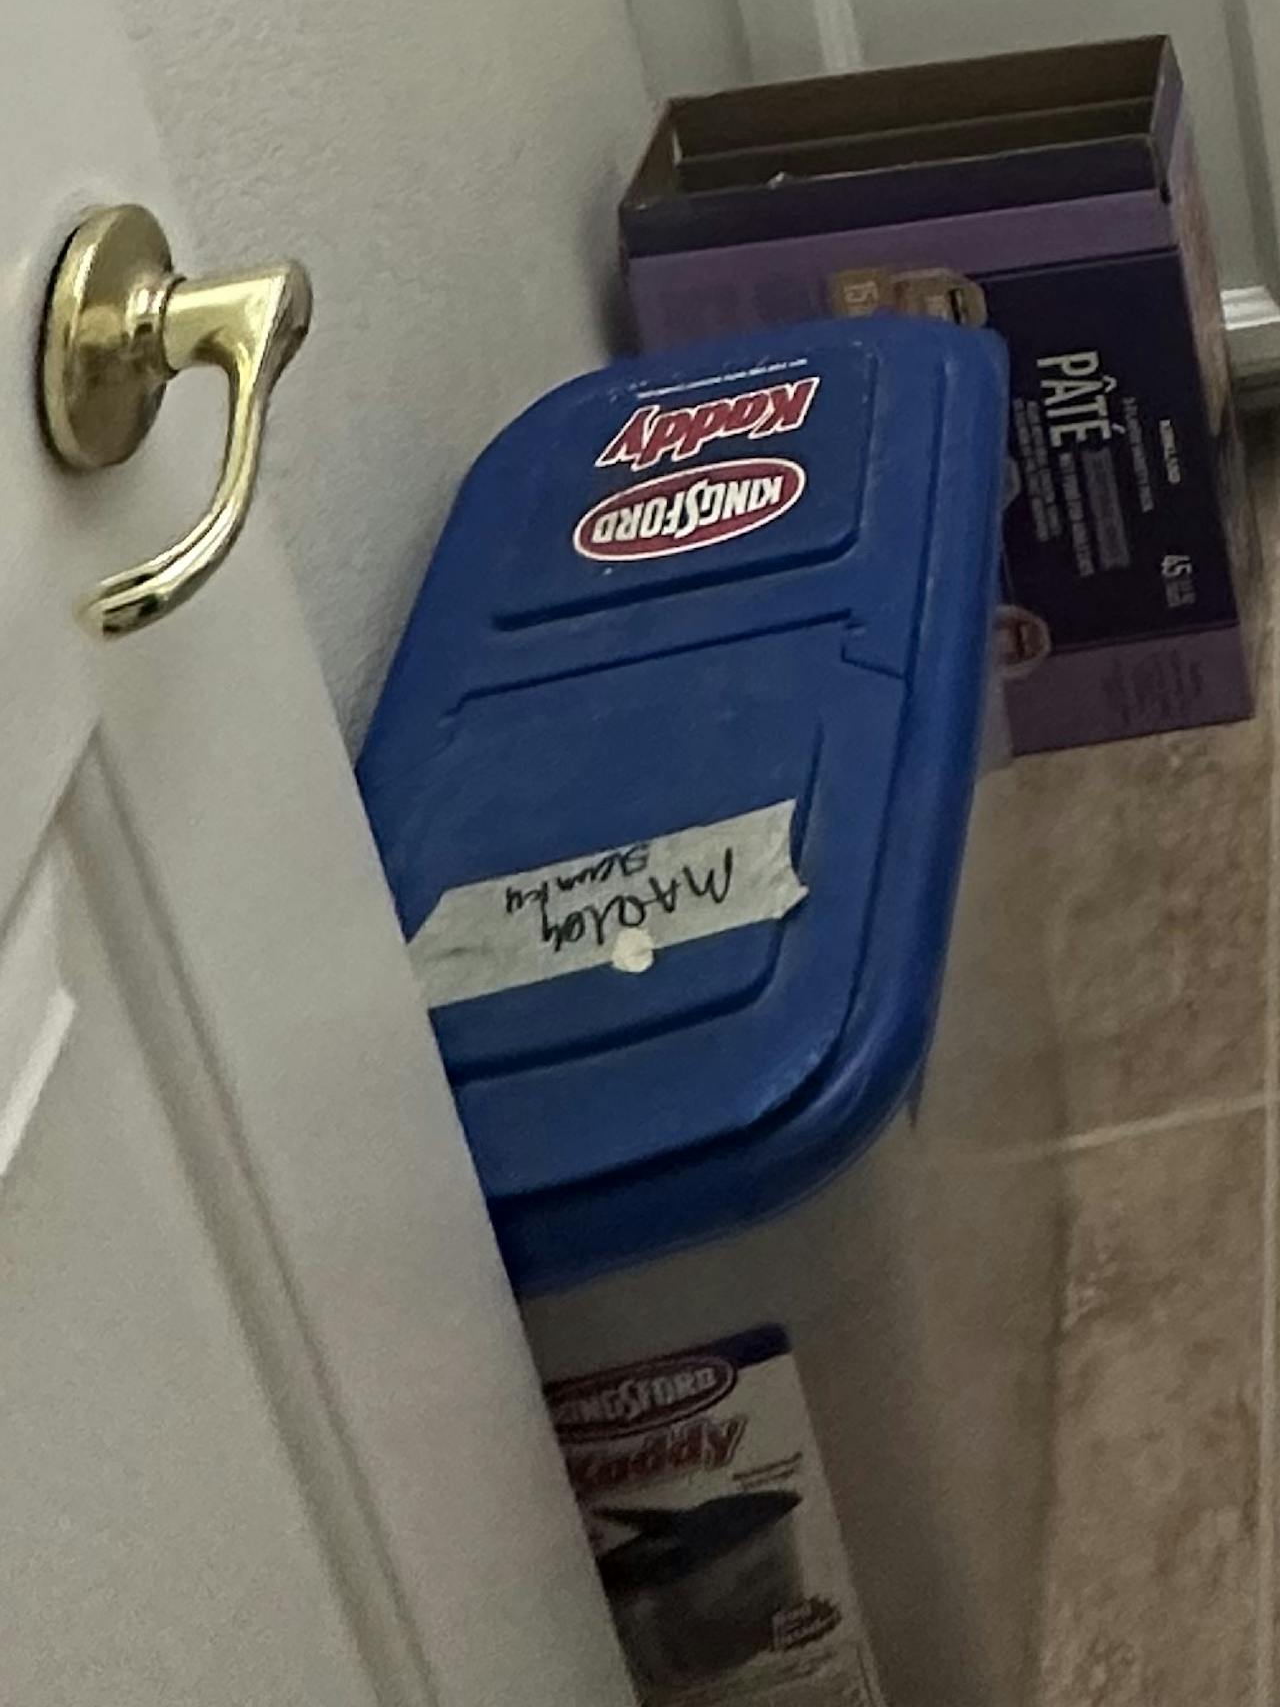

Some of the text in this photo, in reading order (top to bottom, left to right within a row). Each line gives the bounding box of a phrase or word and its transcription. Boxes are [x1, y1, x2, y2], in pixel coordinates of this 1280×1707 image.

[594, 375, 821, 472] Kaddy
[1036, 349, 1126, 448] PÂTÉ
[591, 475, 786, 545] KINGSFORD
[1161, 554, 1193, 578] 45
